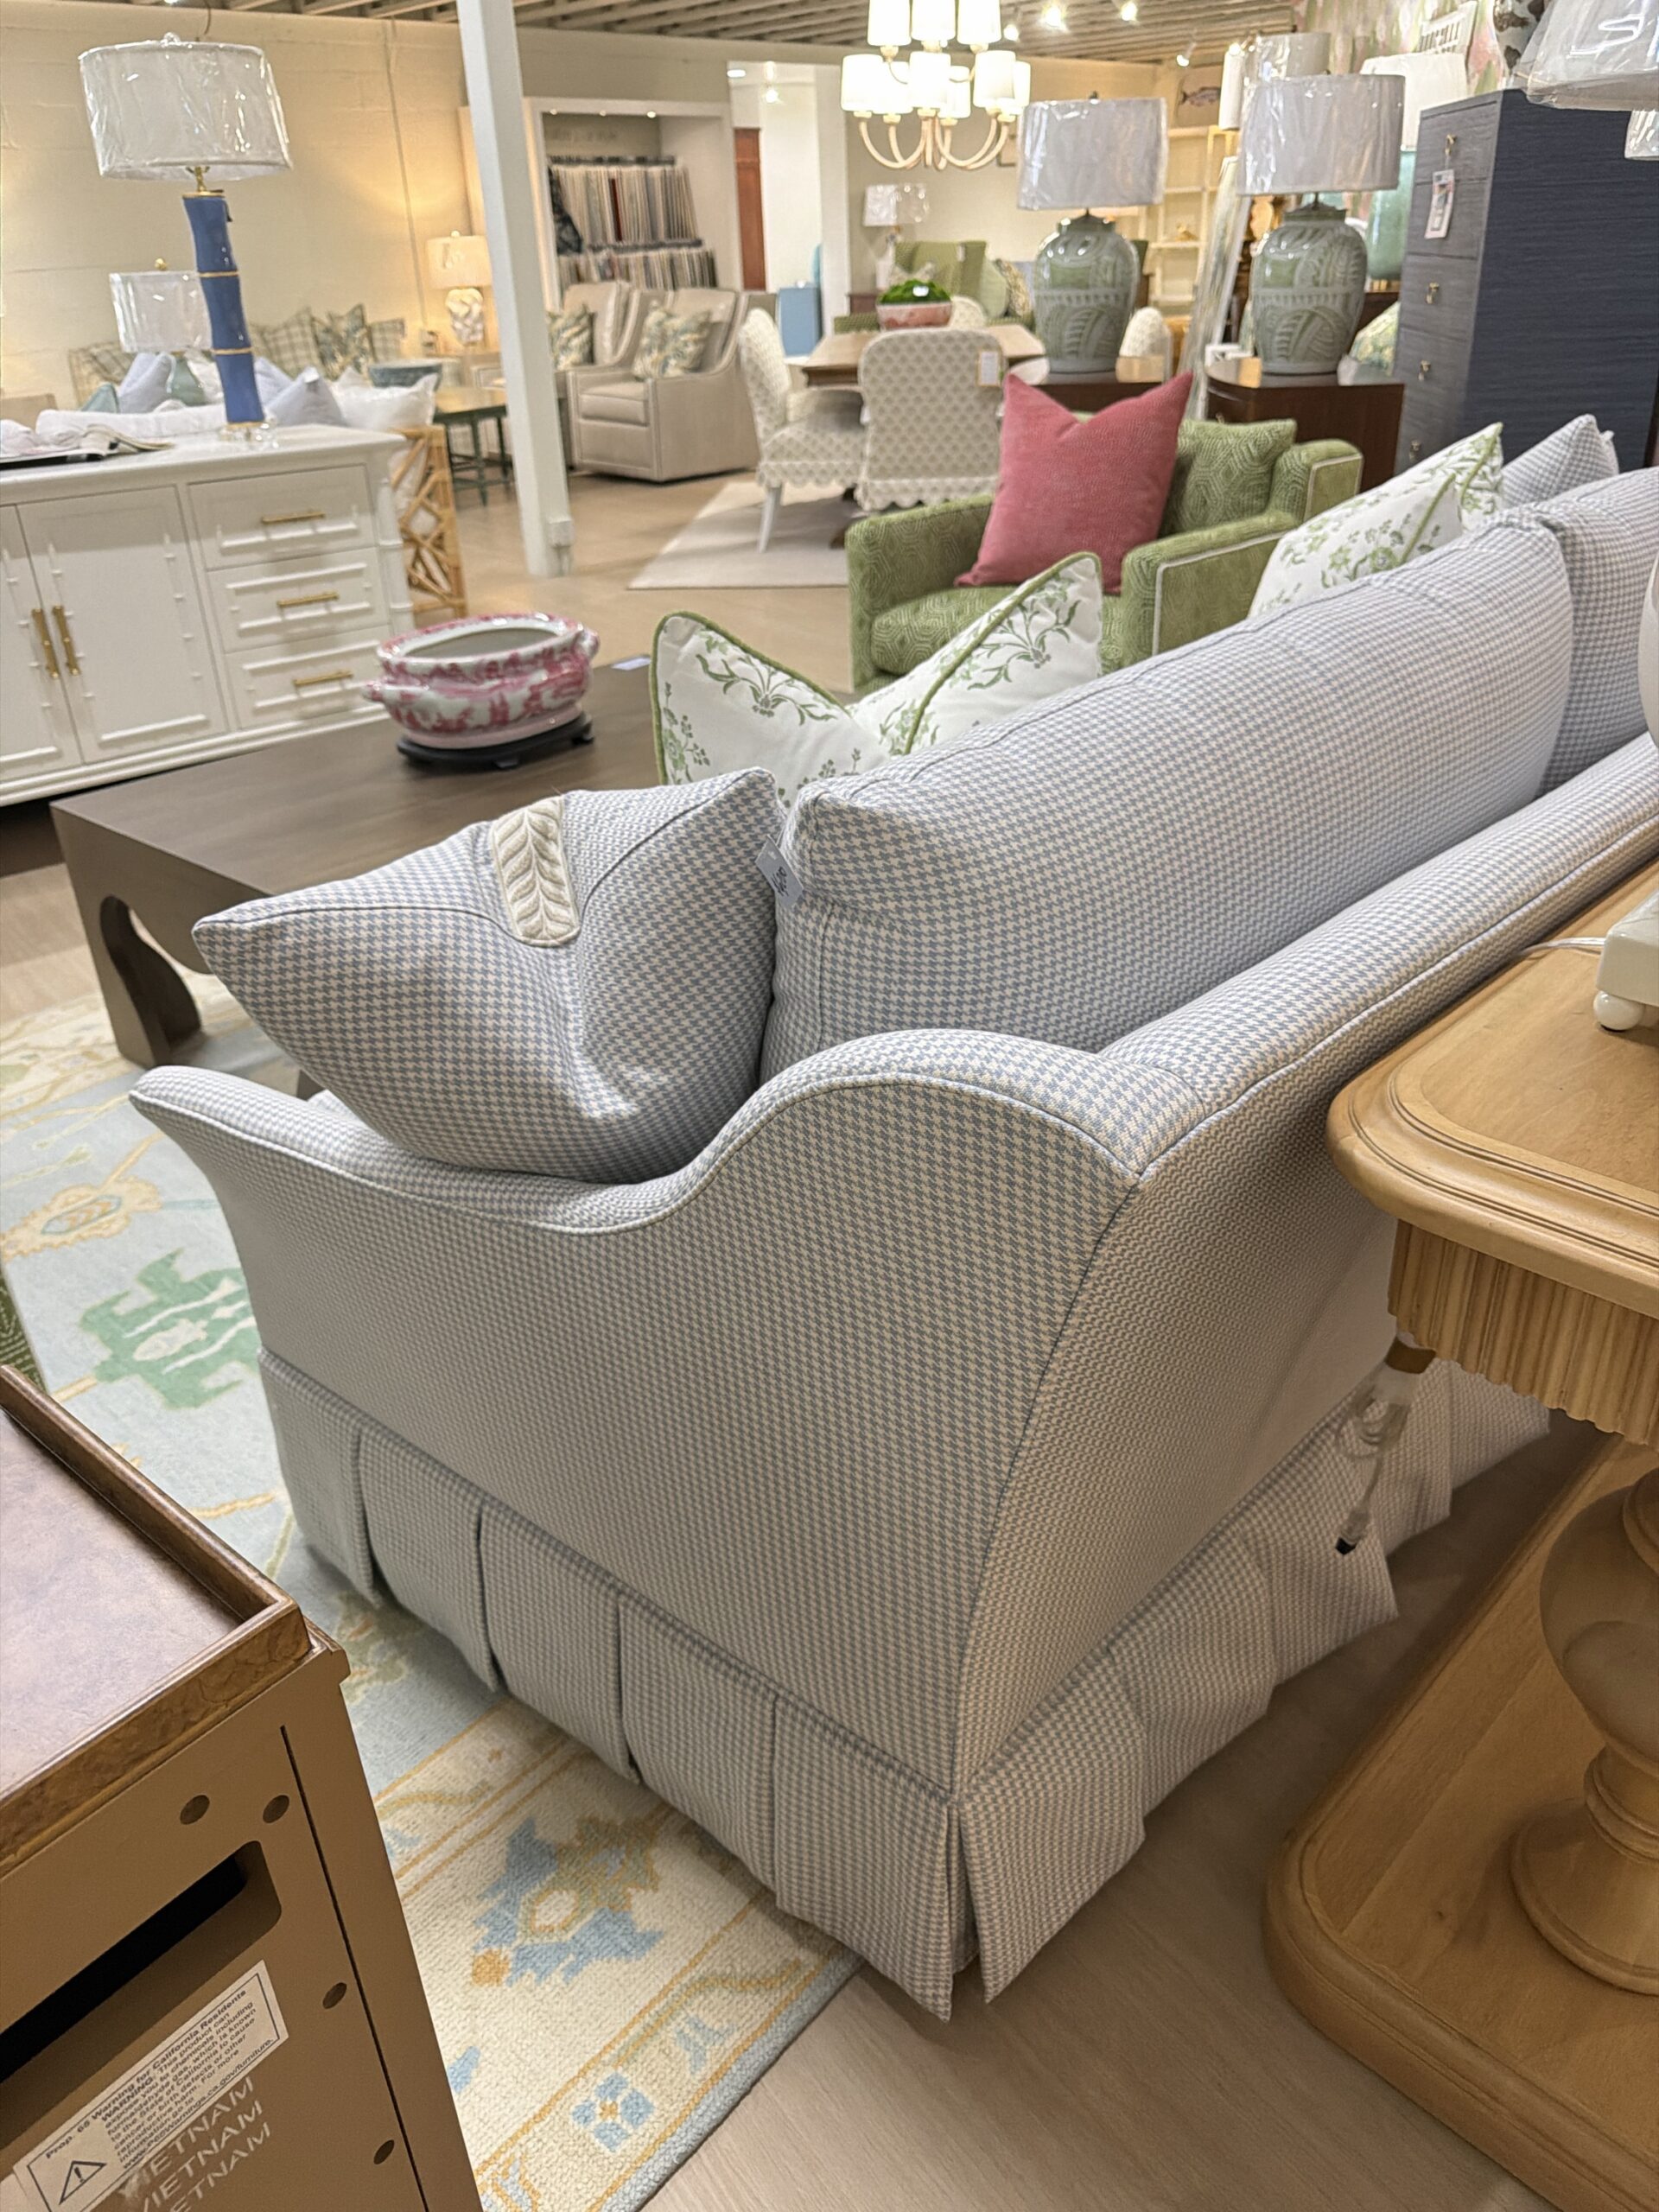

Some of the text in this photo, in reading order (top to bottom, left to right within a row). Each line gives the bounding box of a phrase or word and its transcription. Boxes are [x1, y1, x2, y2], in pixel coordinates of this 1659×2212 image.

[91, 2082, 135, 2122] Warning
[151, 2027, 199, 2070] California
[200, 1987, 246, 2031] Residents
[105, 2097, 139, 2130] expose
[169, 2033, 213, 2073] chemicals
[215, 1999, 253, 2036] including
[106, 2079, 170, 2137] formaldehyde
[192, 2038, 218, 2064] which
[227, 2005, 256, 2033] known
[113, 2120, 146, 2151] cancer
[157, 2090, 179, 2112] birth
[180, 2063, 212, 2093] defects
[224, 2032, 246, 2055] other
[138, 2094, 163, 2118] State
[175, 2047, 218, 2087] California
[229, 2016, 255, 2041] cause
[178, 2025, 212, 2057] product
[116, 2105, 174, 2157] reproductive
[217, 2048, 238, 2069] more
[118, 2115, 171, 2163] information
